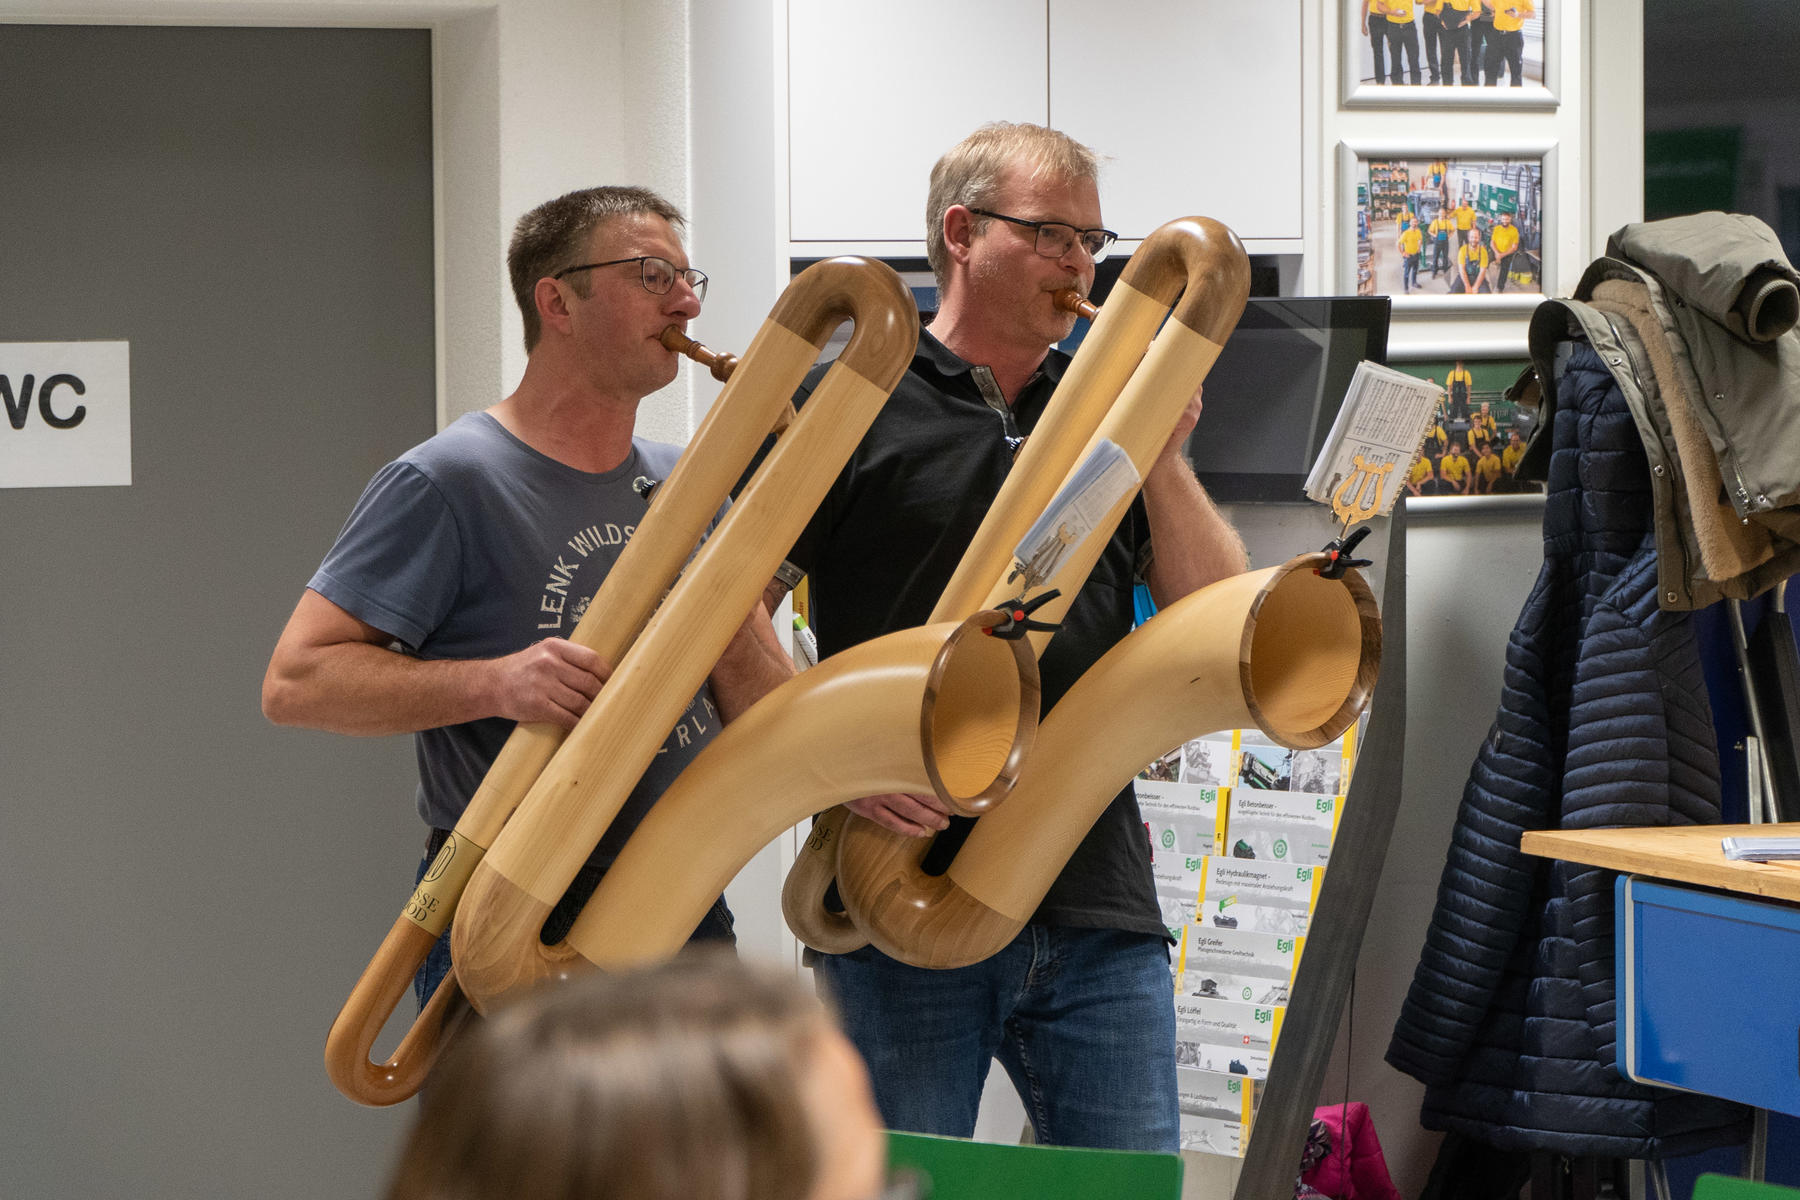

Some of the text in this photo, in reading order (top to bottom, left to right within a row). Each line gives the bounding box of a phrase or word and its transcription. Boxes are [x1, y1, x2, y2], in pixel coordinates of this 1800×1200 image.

[537, 523, 636, 630] LENK WILDS
[1200, 789, 1216, 804] Egli
[1316, 799, 1333, 813] Egli
[1185, 857, 1201, 872] Egli
[1216, 868, 1226, 877] Egli
[1226, 870, 1268, 881] Hydraulikmagnet
[1296, 867, 1312, 882] Egli
[413, 887, 440, 913] SSE
[1198, 937, 1207, 946] Egli
[1277, 938, 1294, 954] Egli
[1177, 1005, 1187, 1015] Egli
[1254, 1008, 1272, 1024] Egli
[1227, 1079, 1241, 1094] Egli
